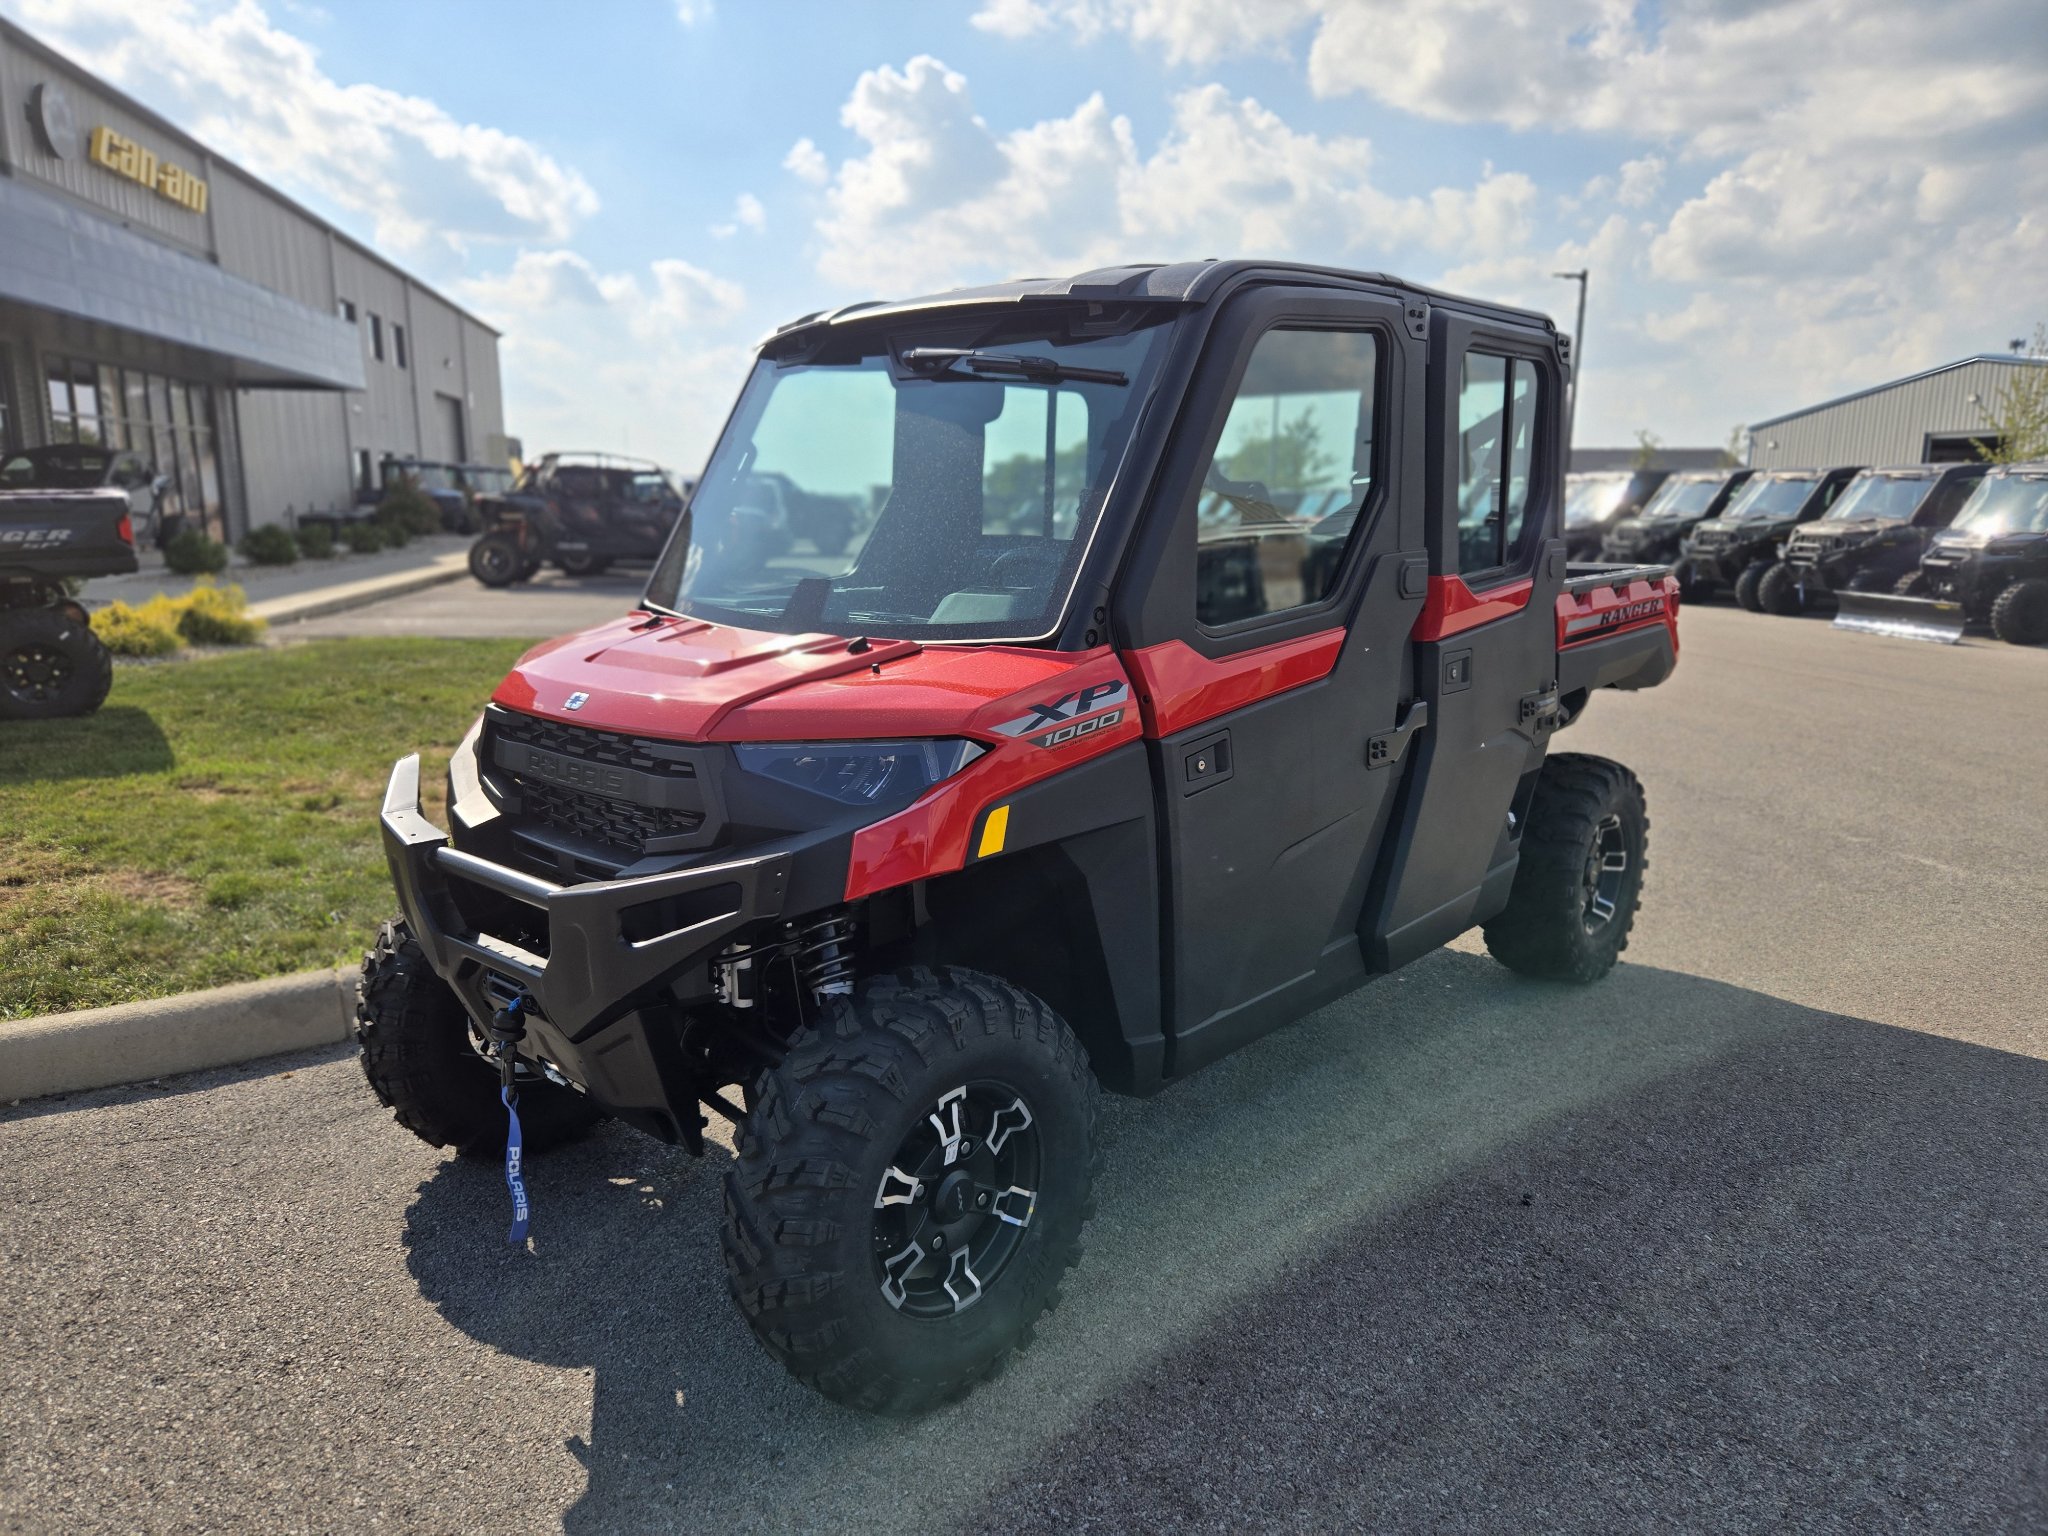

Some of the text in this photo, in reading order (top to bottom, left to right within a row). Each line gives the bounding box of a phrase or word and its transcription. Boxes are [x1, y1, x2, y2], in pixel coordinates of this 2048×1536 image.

[92, 125, 207, 214] can-am
[0, 529, 72, 542] GER
[1600, 599, 1660, 625] RANGER
[1017, 679, 1125, 735] XP
[1044, 711, 1120, 747] 1000
[528, 751, 624, 796] POLARIS
[508, 1146, 528, 1222] POLARIS
